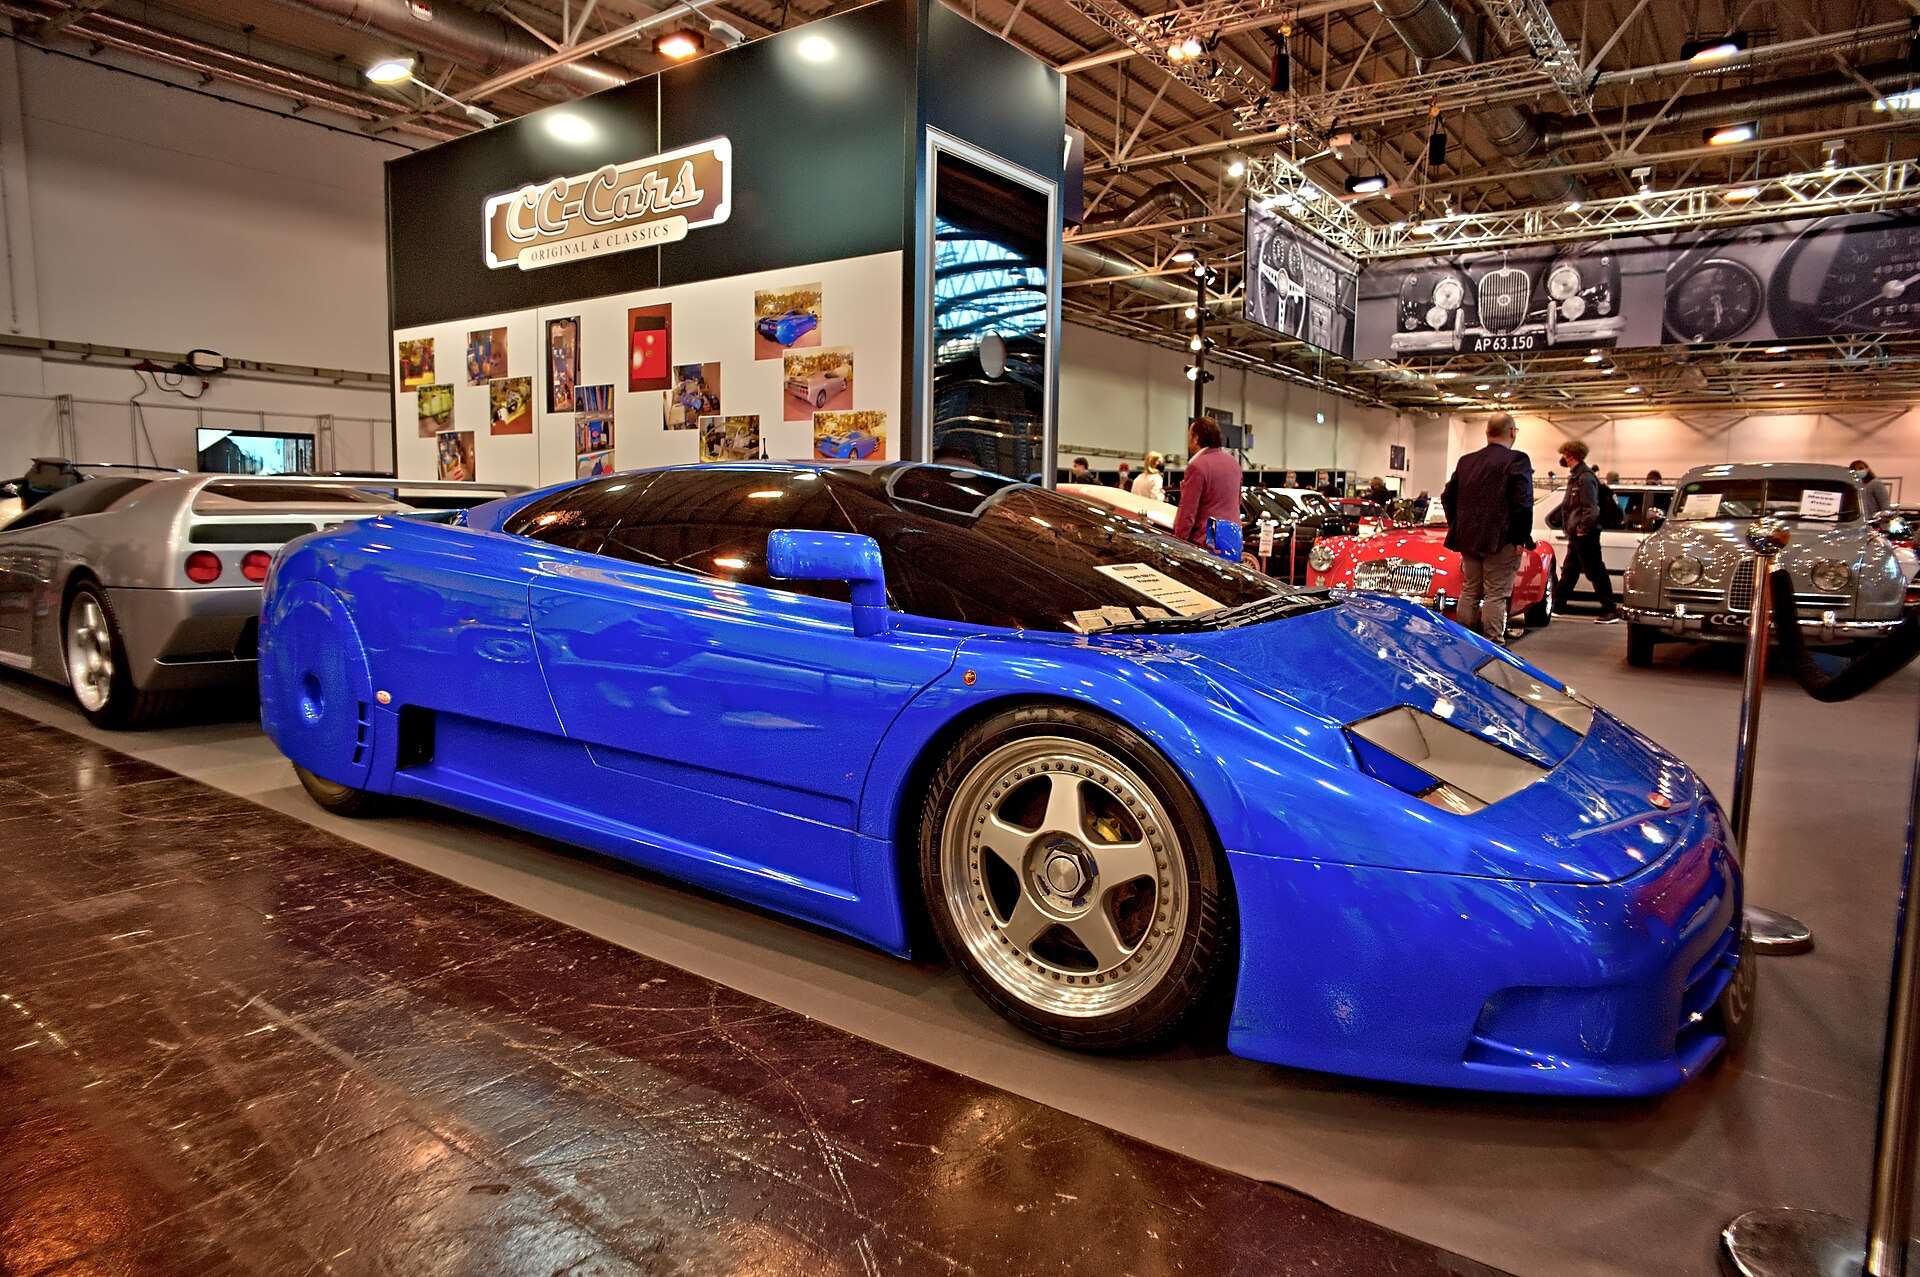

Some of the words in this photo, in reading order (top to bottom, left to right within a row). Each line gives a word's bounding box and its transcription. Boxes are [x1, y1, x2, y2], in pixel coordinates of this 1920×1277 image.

[507, 161, 704, 241] CC-Cars
[531, 240, 586, 261] ORIGINAL
[592, 239, 600, 250] &
[606, 224, 669, 247] CLASSICS
[1474, 338, 1491, 352] AP
[1493, 335, 1533, 351] 63.150
